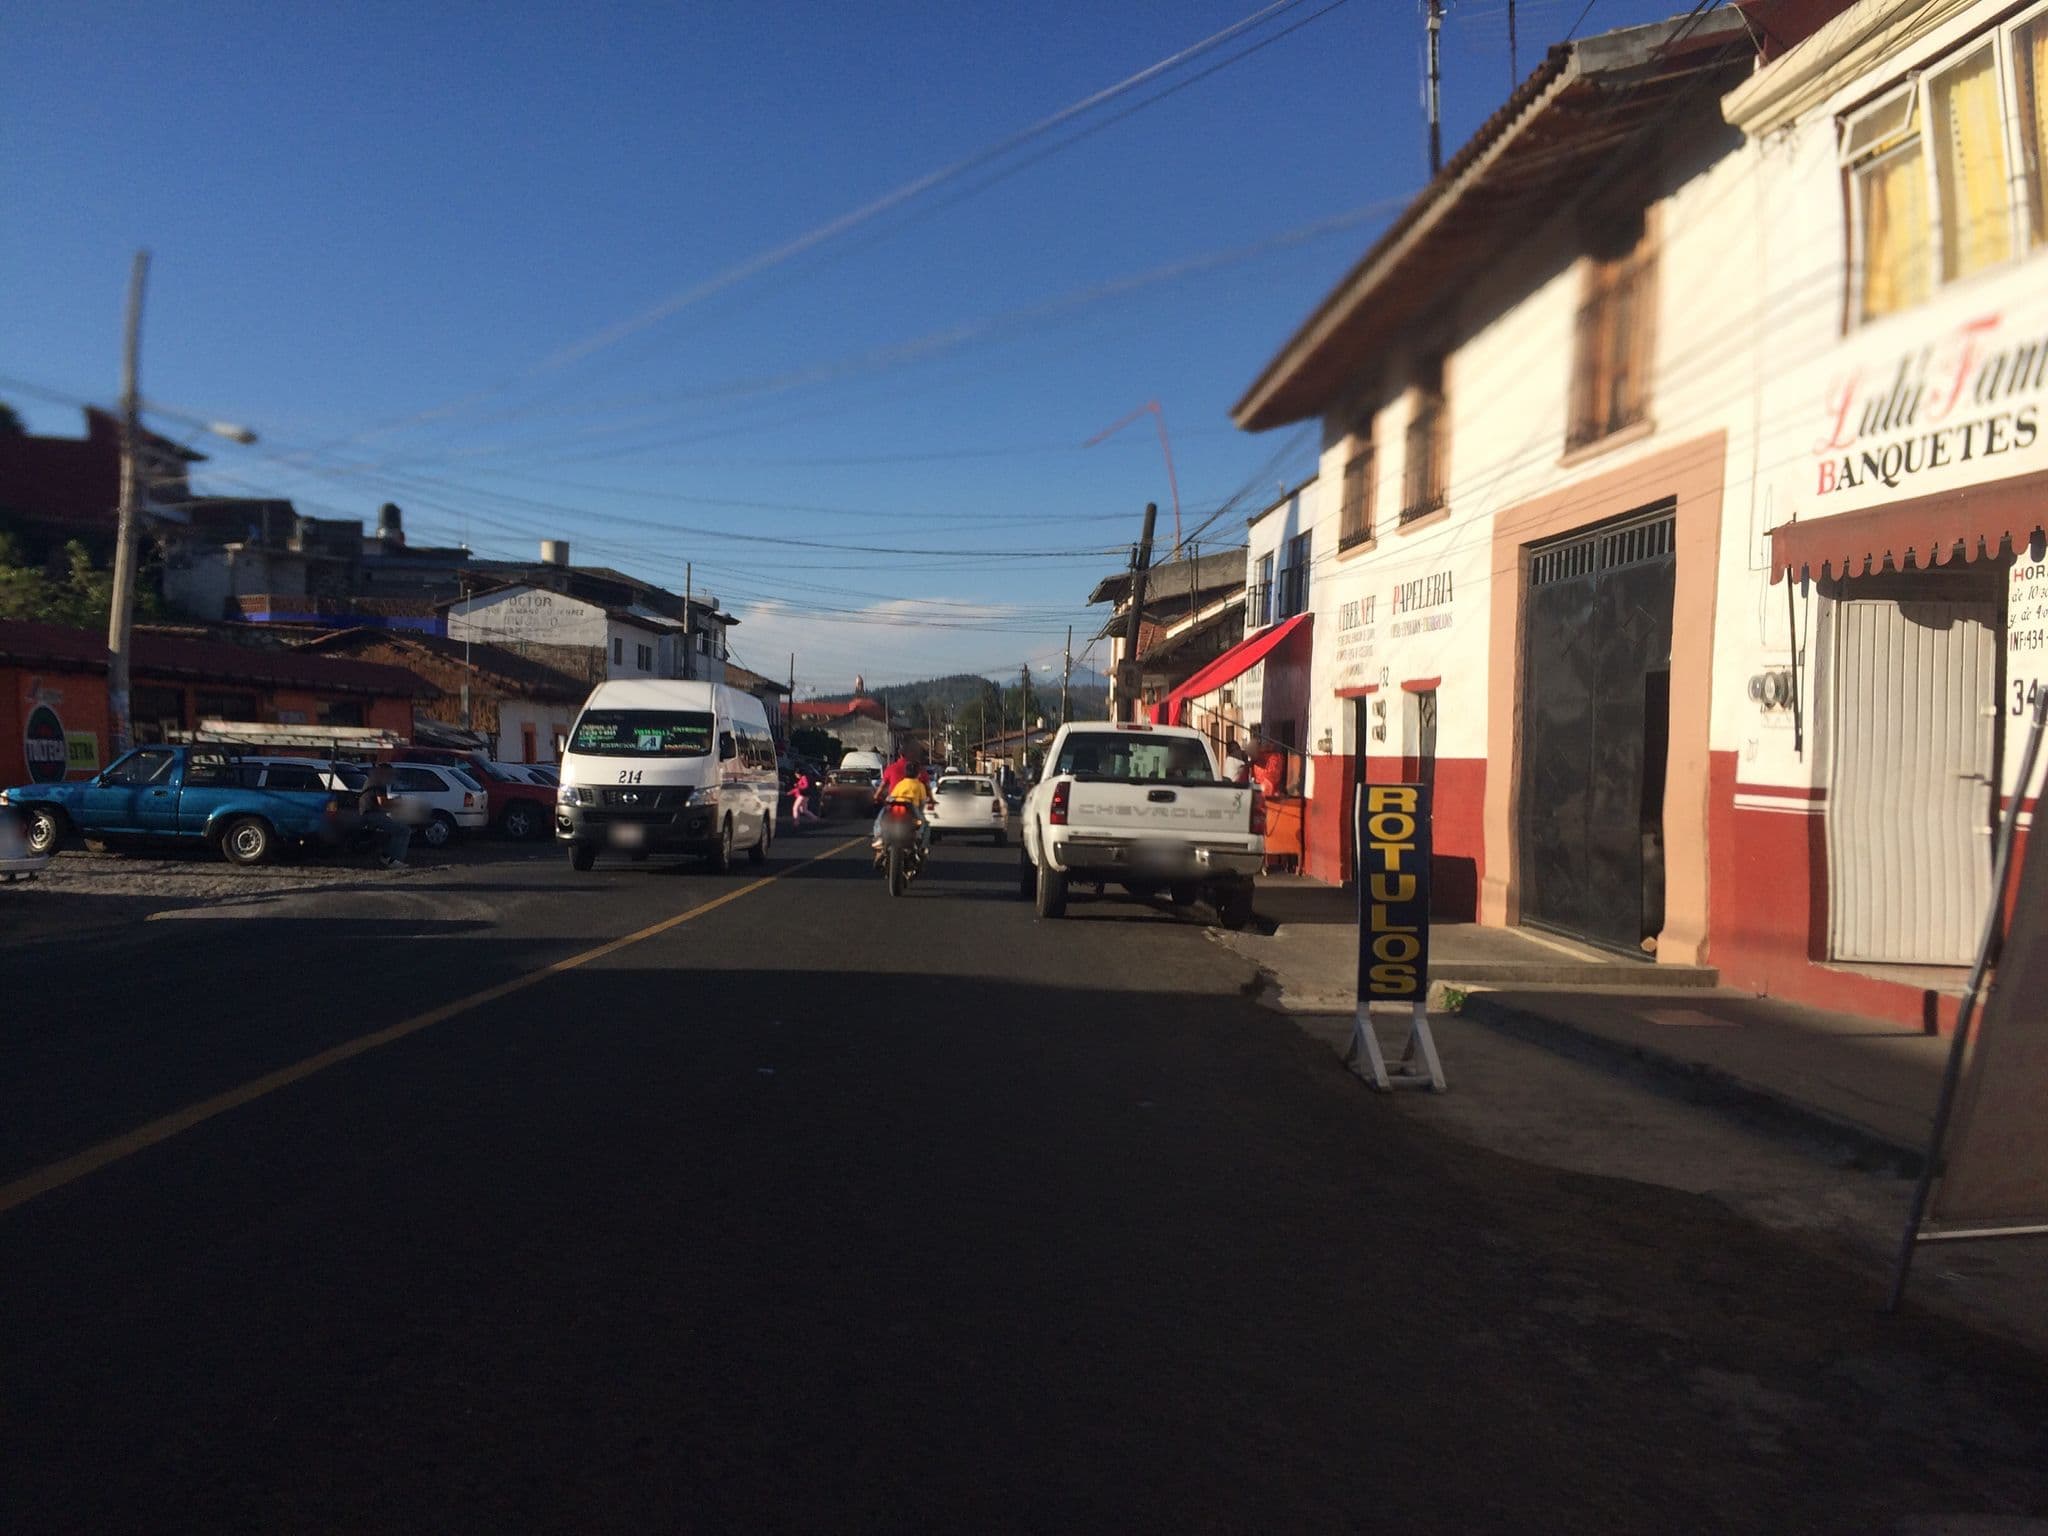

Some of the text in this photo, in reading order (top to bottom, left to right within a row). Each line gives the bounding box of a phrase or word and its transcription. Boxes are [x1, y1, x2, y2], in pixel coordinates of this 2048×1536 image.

[1817, 404, 2038, 496] BANQUETES
[2014, 564, 2048, 582] HOR
[1392, 570, 1453, 615] PAPELERIA
[618, 770, 643, 784] 214
[1078, 803, 1241, 820] CHEVROLET
[1367, 786, 1421, 995] ROTULOS
